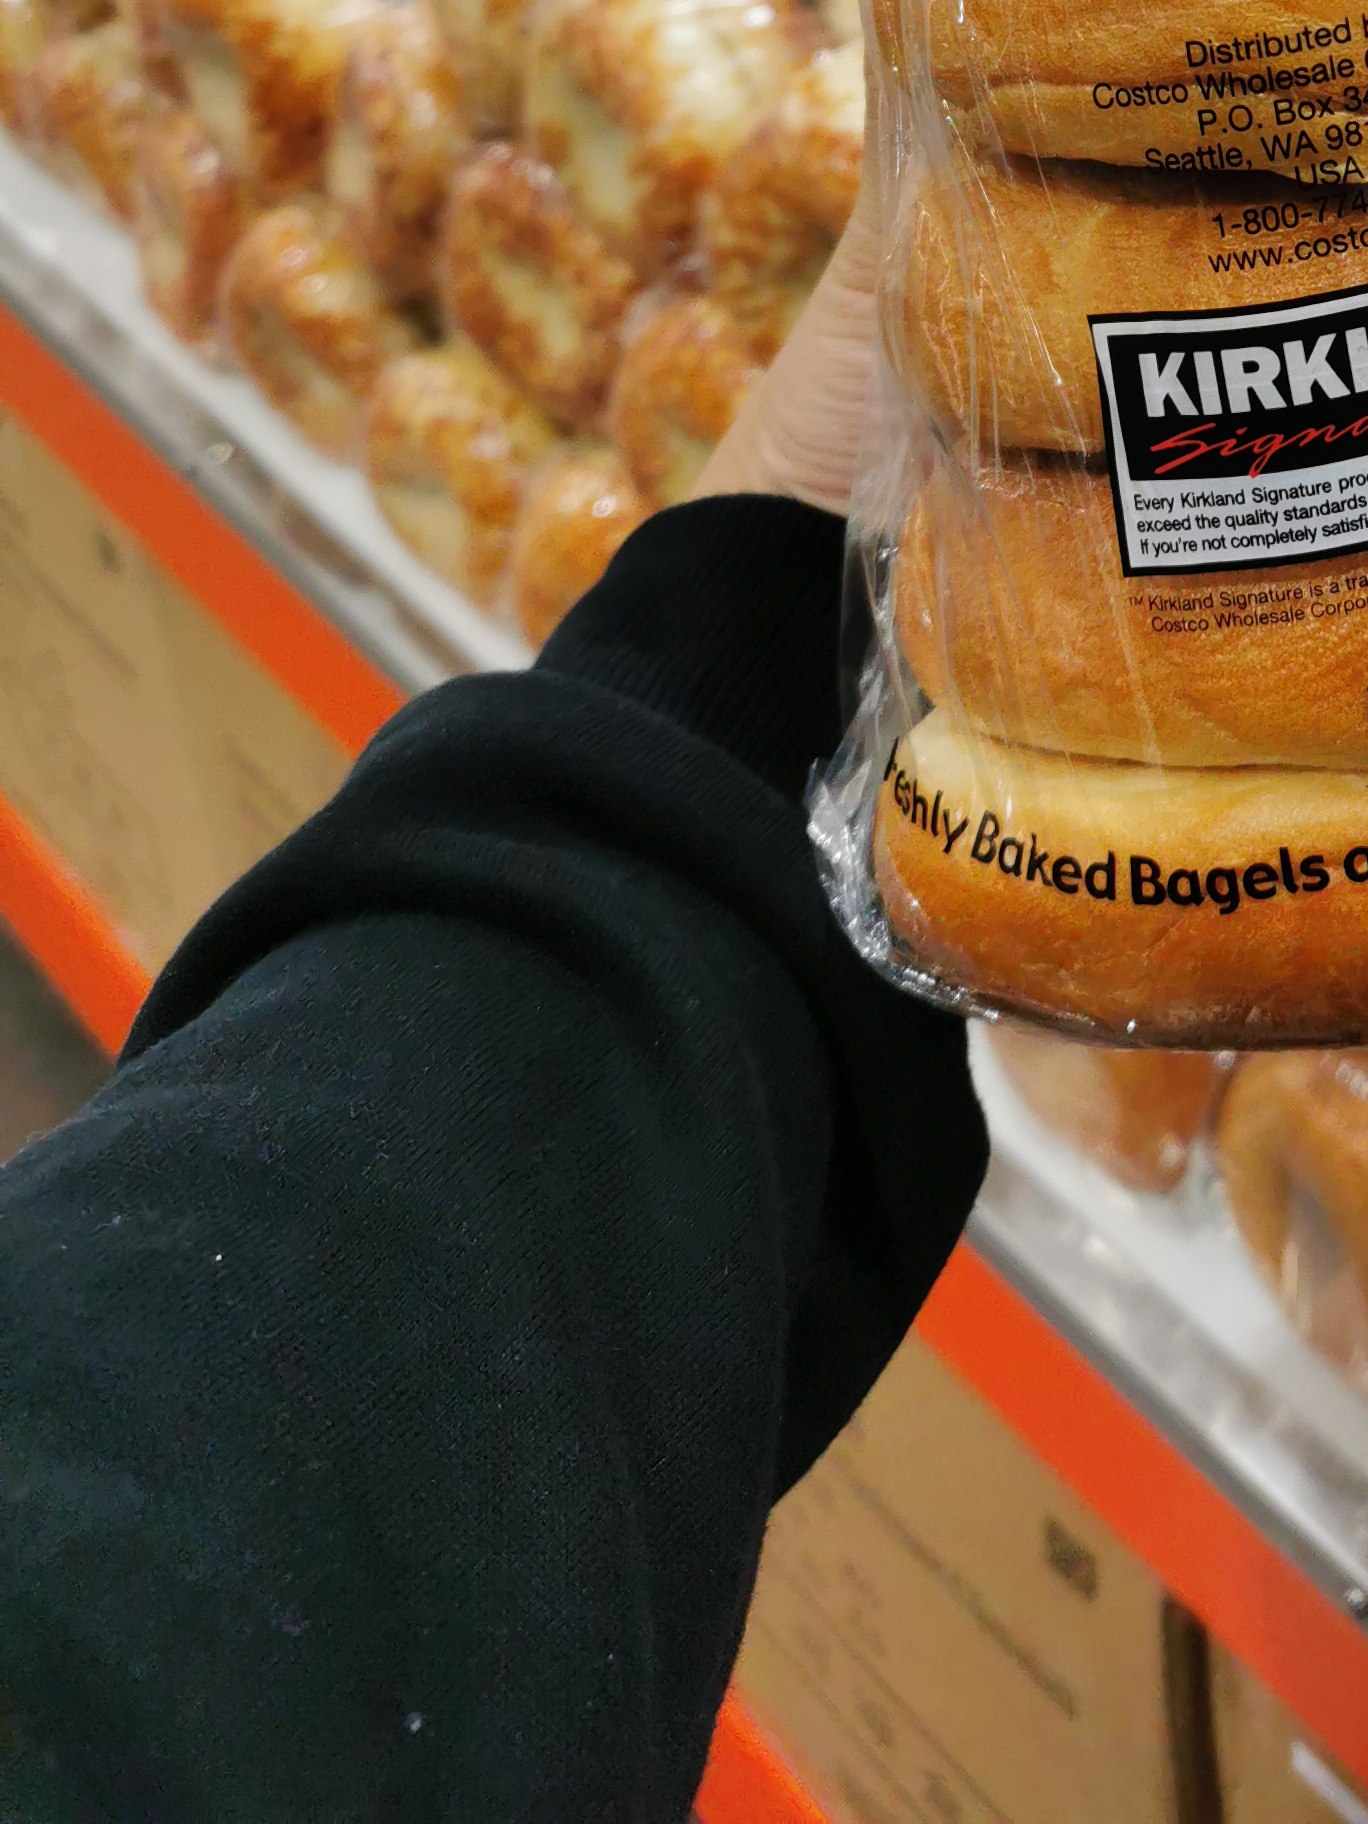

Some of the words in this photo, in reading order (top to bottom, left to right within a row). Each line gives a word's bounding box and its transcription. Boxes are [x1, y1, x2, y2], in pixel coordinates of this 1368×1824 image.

[1185, 18, 1352, 69] Distributed
[1092, 82, 1189, 110] Costco
[1195, 57, 1356, 101] Wholesale
[1197, 106, 1265, 137] P.O.
[1274, 88, 1335, 127] Box
[1144, 144, 1253, 176] Seattle,
[1260, 127, 1319, 164] WA
[1293, 155, 1365, 190] USA
[1133, 493, 1175, 513] Every
[1180, 488, 1246, 509] Kirkland
[1251, 479, 1332, 505] Signature
[1137, 515, 1191, 533] exceed
[1195, 513, 1221, 529] the
[1225, 509, 1279, 531] quality
[1283, 493, 1368, 522] standards
[1140, 538, 1150, 555] If
[1153, 537, 1198, 558] you're
[1202, 534, 1227, 551] not
[1230, 525, 1318, 549] completely
[1148, 592, 1214, 612] Kirkland
[1219, 585, 1304, 609] Signature
[1310, 582, 1324, 597] is
[1329, 580, 1341, 594] a
[1151, 615, 1210, 633] Costco
[1213, 607, 1305, 629] Wholesale
[971, 810, 1117, 901] Baked
[1129, 847, 1331, 915] Bagels
